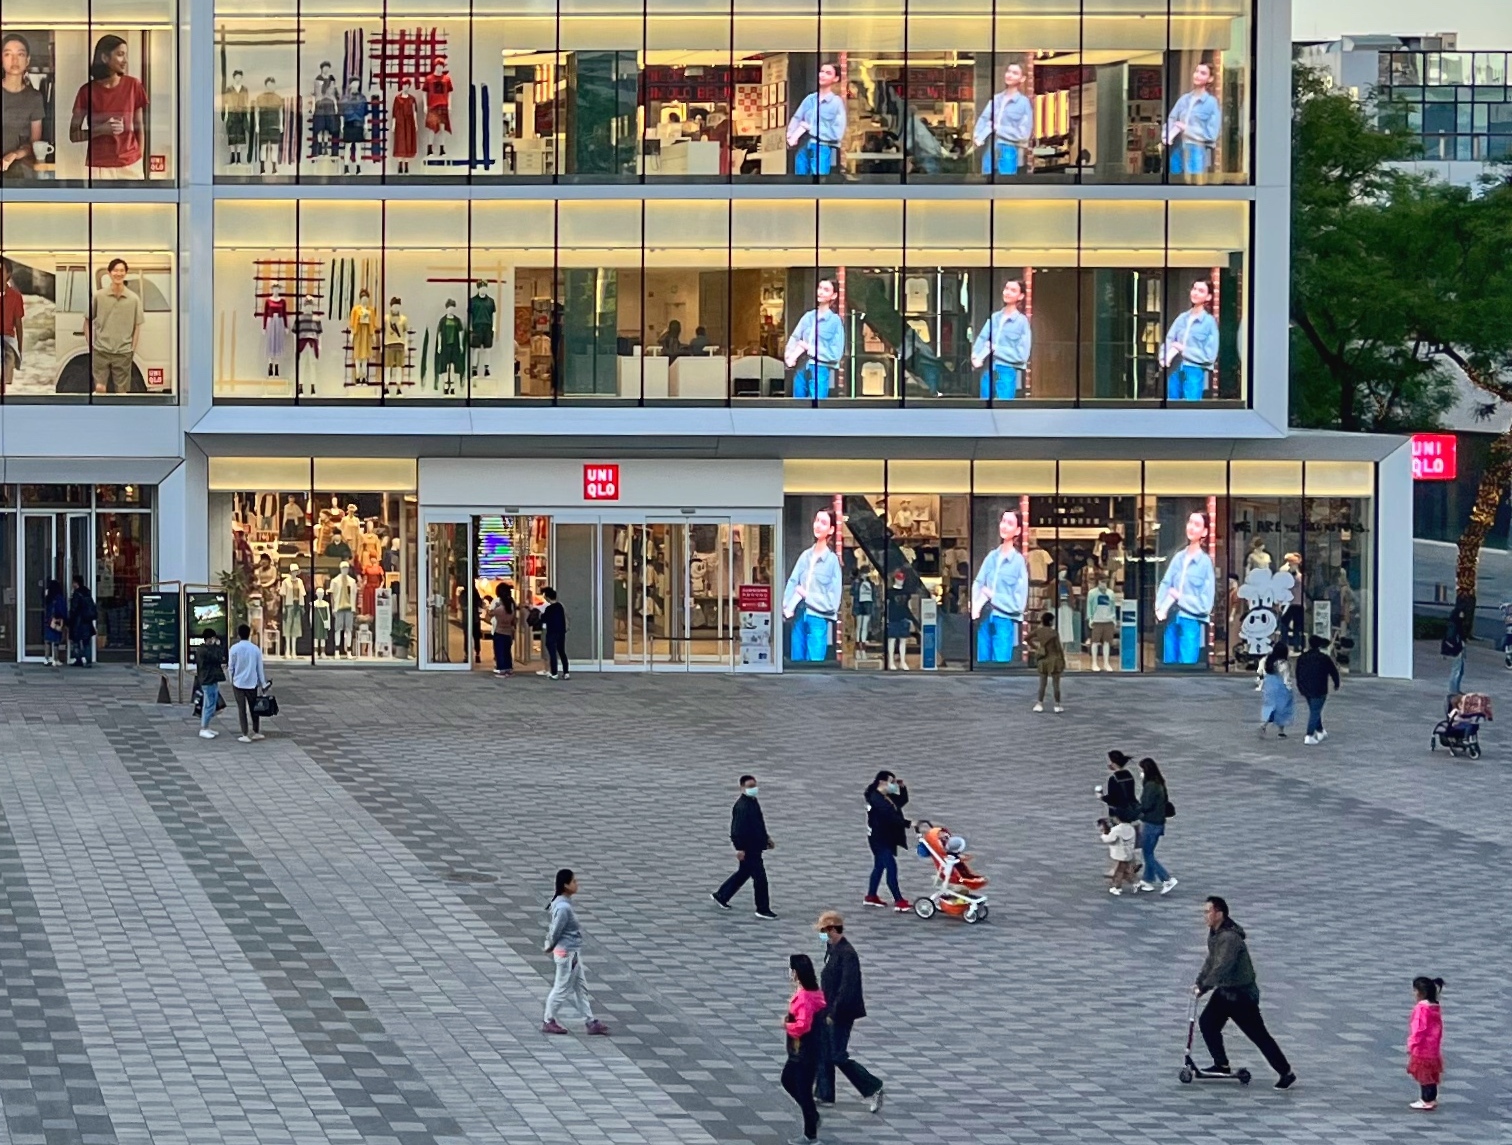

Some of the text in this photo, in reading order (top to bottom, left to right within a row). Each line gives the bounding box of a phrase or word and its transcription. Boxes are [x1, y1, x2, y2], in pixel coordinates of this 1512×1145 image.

[150, 163, 164, 171] QLO
[1411, 441, 1442, 456] UNI
[587, 469, 613, 481] UNI
[1411, 458, 1444, 477] QLO
[587, 483, 615, 498] QLO
